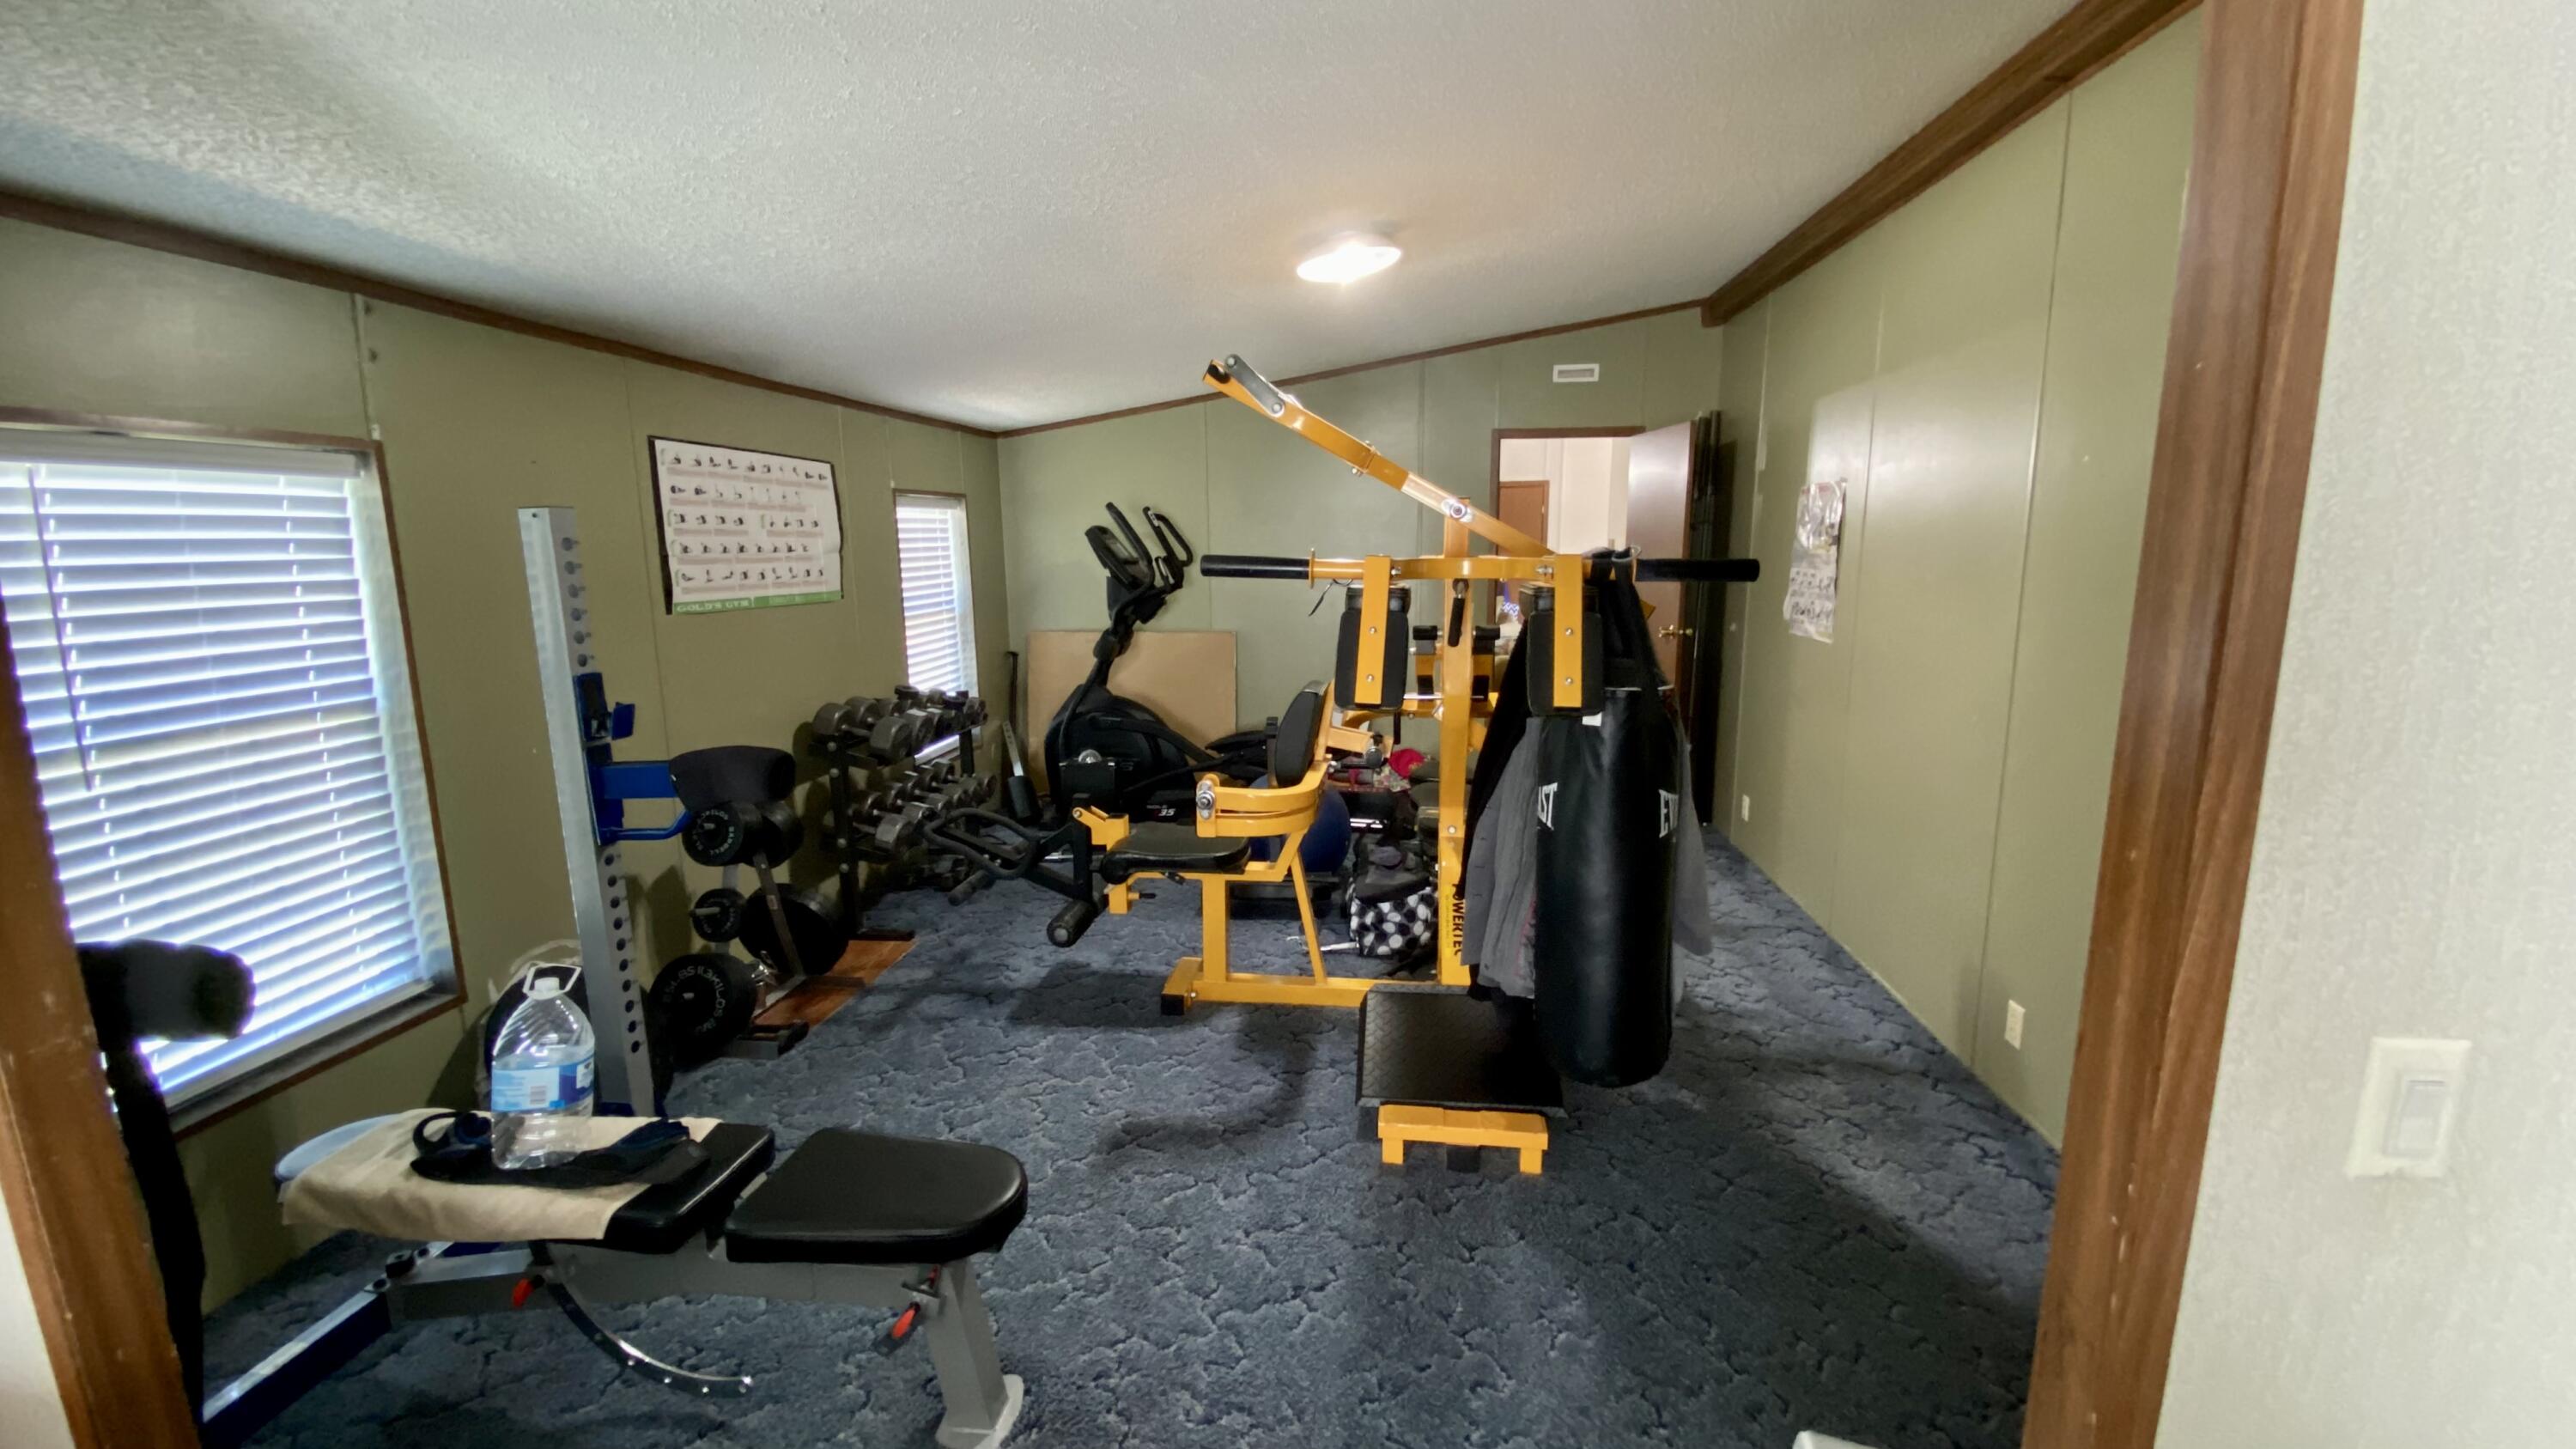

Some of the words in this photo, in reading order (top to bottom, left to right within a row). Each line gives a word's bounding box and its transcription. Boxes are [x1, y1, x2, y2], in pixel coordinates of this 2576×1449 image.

[677, 602, 722, 612] GOLD'S
[726, 600, 749, 609] GYM
[1538, 782, 1558, 831] ST
